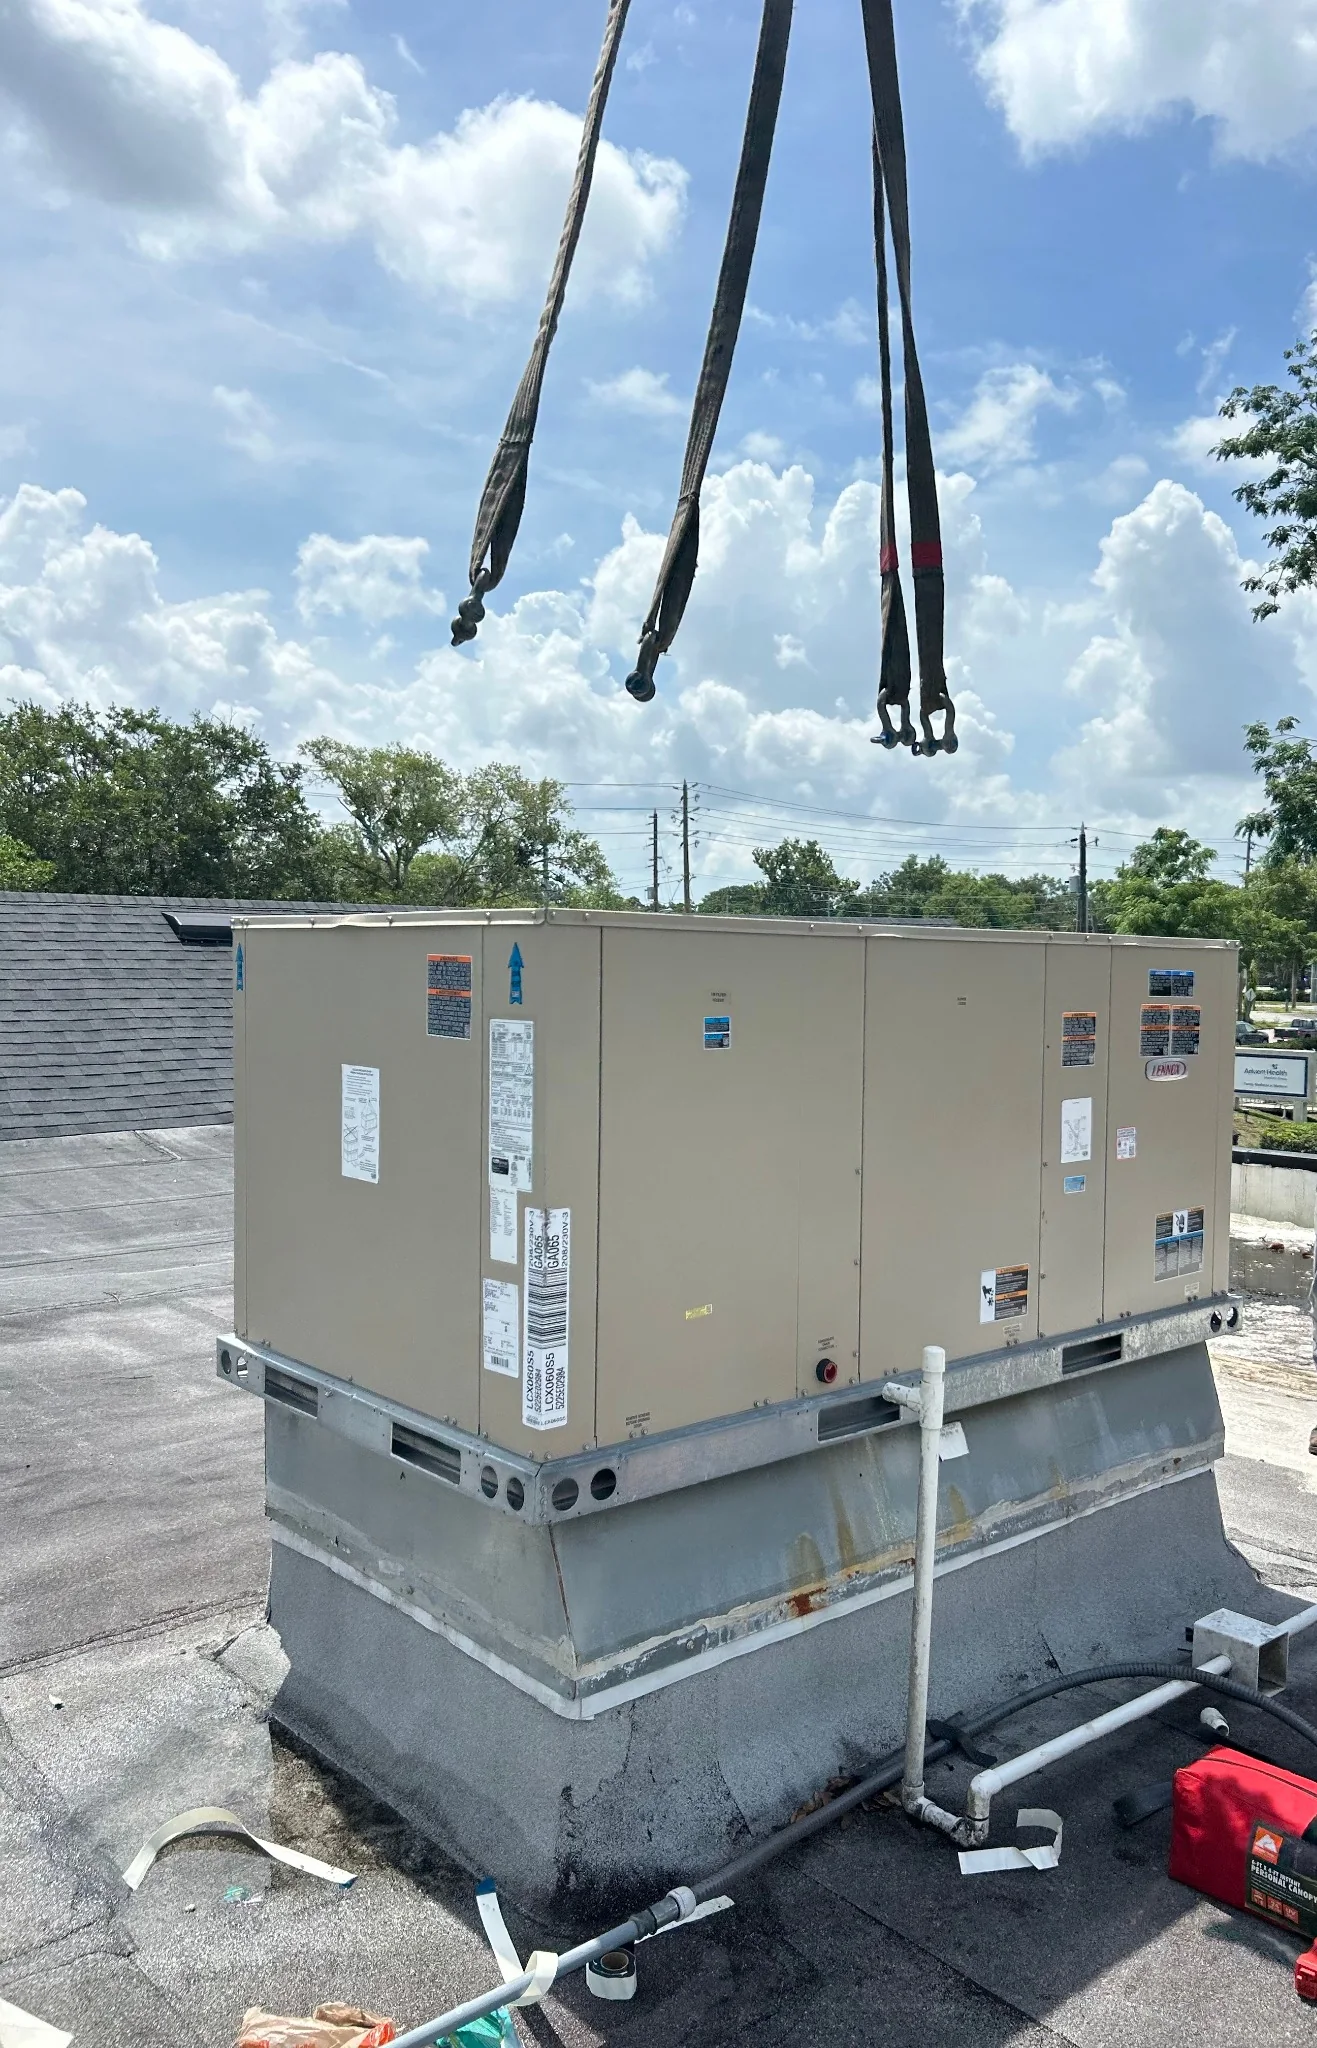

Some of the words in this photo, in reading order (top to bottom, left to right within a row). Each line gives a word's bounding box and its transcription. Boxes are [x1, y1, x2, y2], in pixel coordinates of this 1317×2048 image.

[1151, 1064, 1180, 1076] LENNOX
[534, 1235, 543, 1268] GA065
[547, 1235, 559, 1268] GA065
[545, 1353, 554, 1411] LCX060S5
[1251, 1865, 1286, 1888] PERSONAL
[1288, 1885, 1317, 1903] CANOPY
[1279, 1873, 1301, 1888] INSTANT
